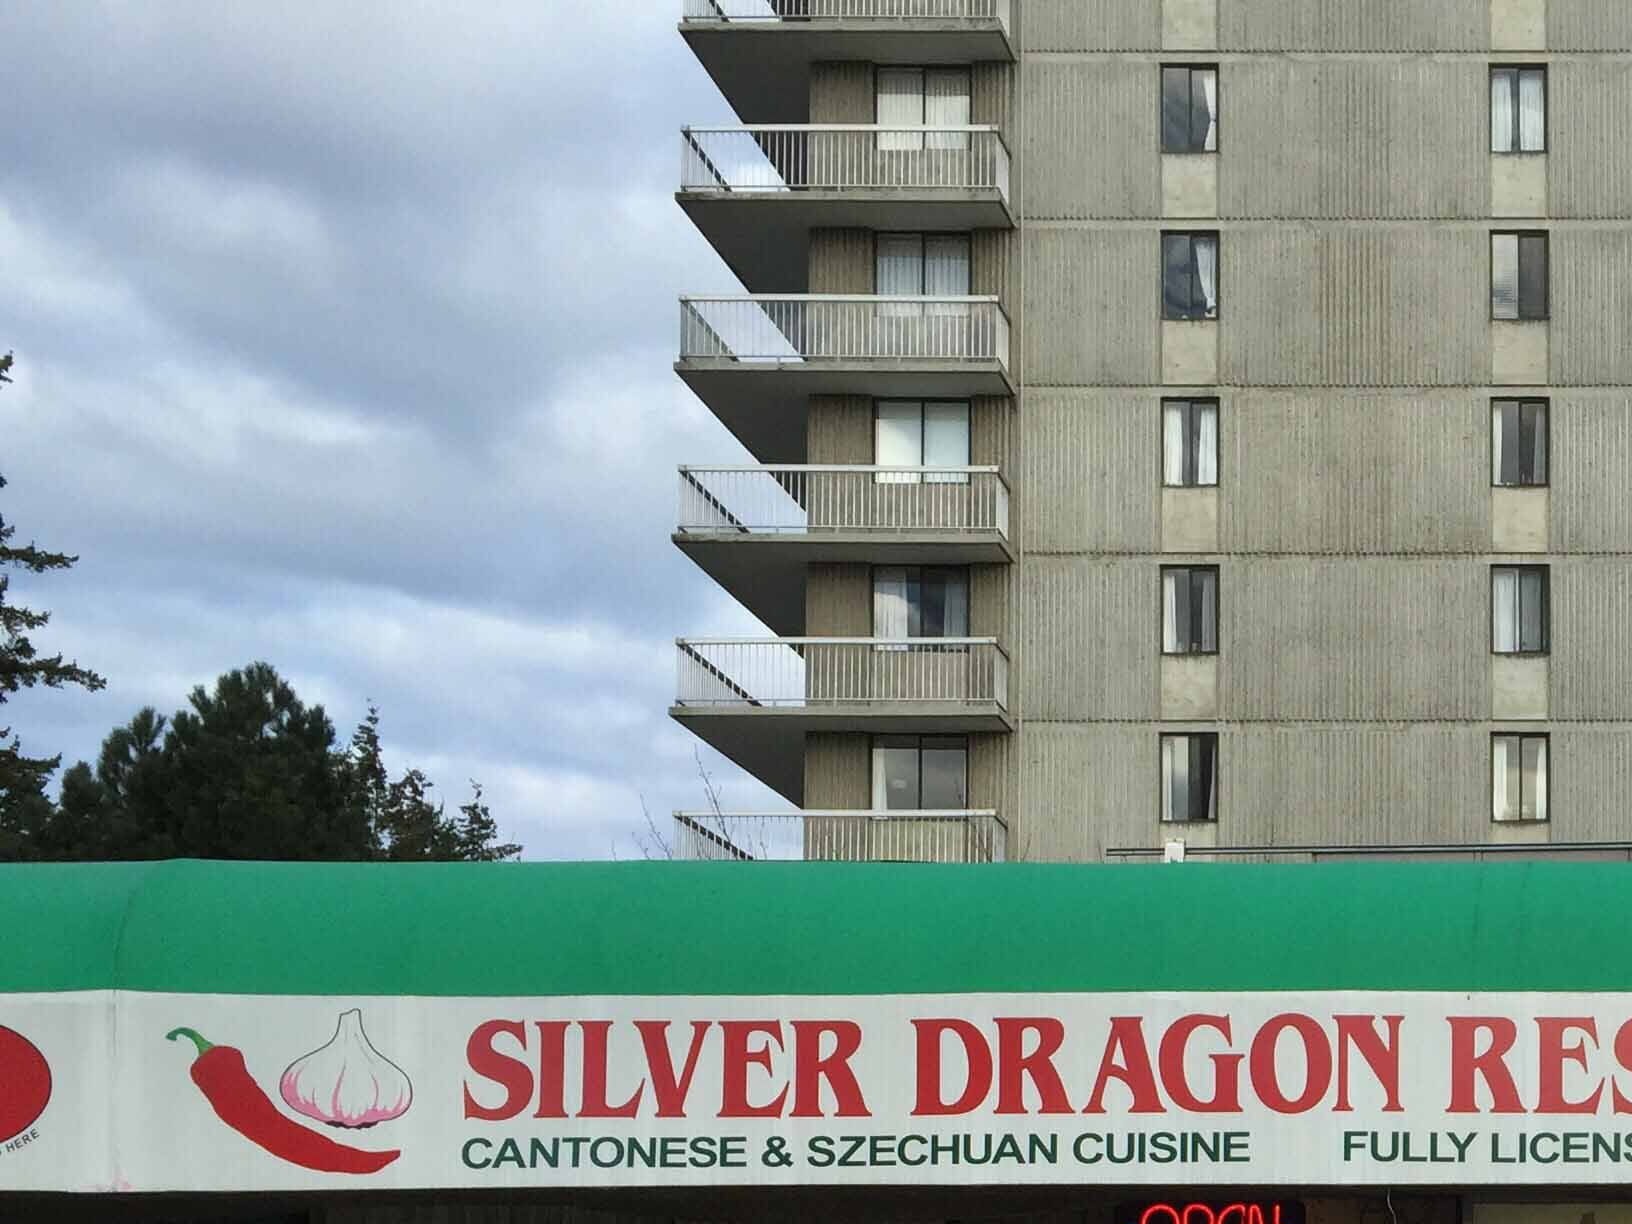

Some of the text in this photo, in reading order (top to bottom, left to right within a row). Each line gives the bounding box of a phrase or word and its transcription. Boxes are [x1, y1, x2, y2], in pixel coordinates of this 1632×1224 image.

[463, 1019, 870, 1120] SILVER
[911, 1014, 1403, 1117] DRAGON
[5, 1128, 40, 1152] HERE
[462, 1131, 1250, 1168] CANTONESE & SZECHUAN CUISINE
[1343, 1132, 1478, 1163] FULLY
